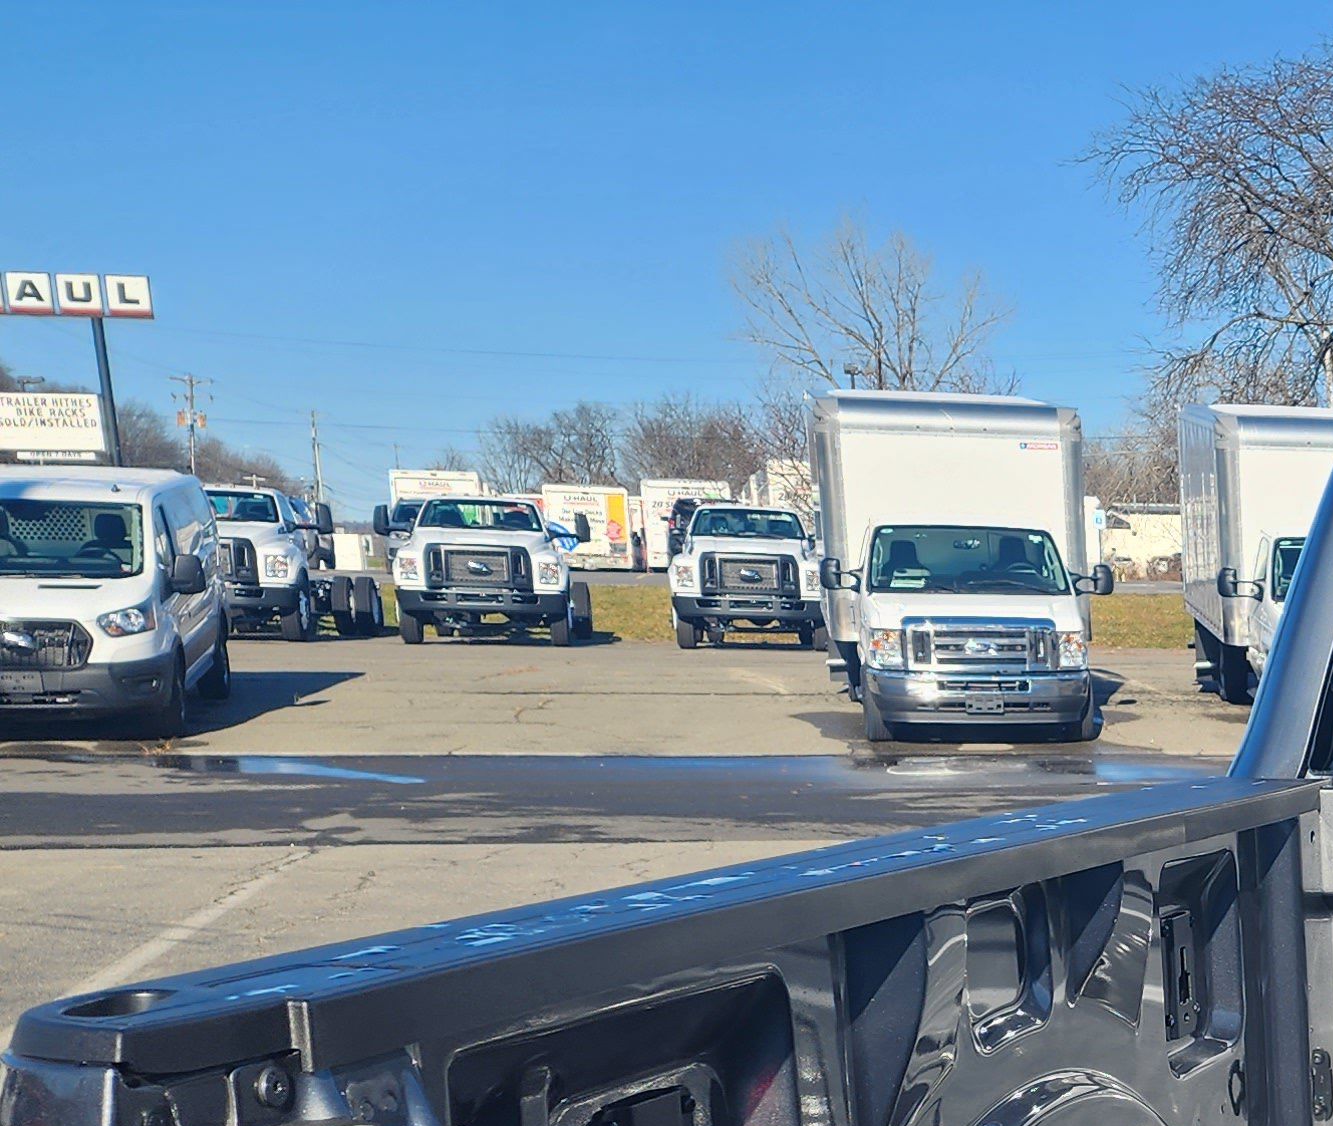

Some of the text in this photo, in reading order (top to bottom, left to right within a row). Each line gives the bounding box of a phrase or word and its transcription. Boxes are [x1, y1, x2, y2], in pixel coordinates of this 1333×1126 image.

[0, 396, 47, 408] TRAILER
[16, 407, 86, 418] BIKE RACKS
